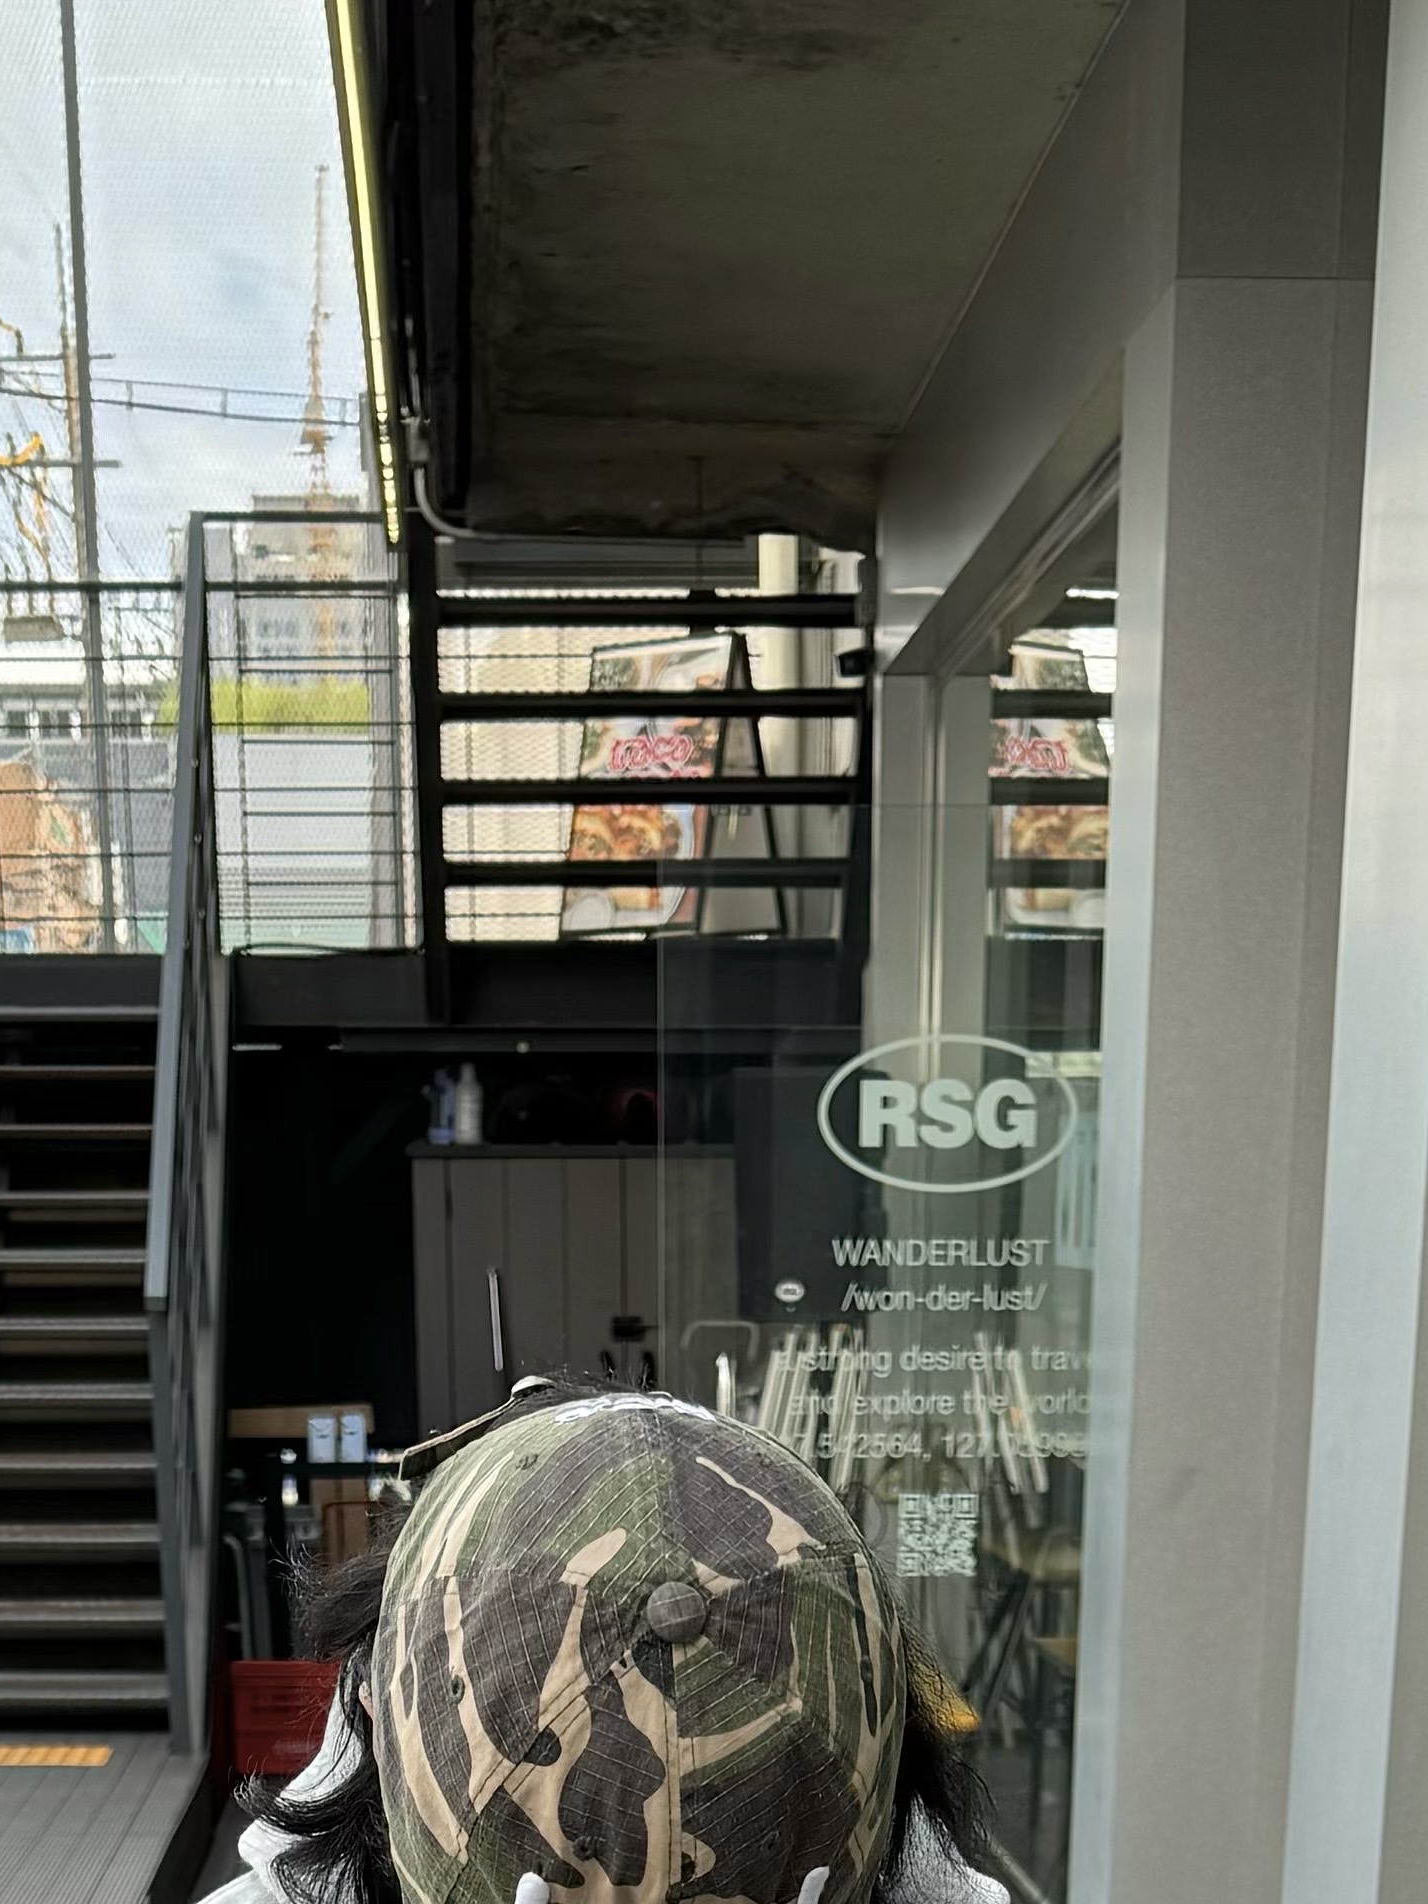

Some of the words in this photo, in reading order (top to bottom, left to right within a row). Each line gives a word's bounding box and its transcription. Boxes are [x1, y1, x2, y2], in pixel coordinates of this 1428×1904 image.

[858, 1078, 1039, 1150] RSG
[831, 1237, 1052, 1268] WANDERLUST
[840, 1281, 1049, 1312] /won-der-lust/
[899, 1344, 986, 1371] desire
[854, 1388, 956, 1422] explore
